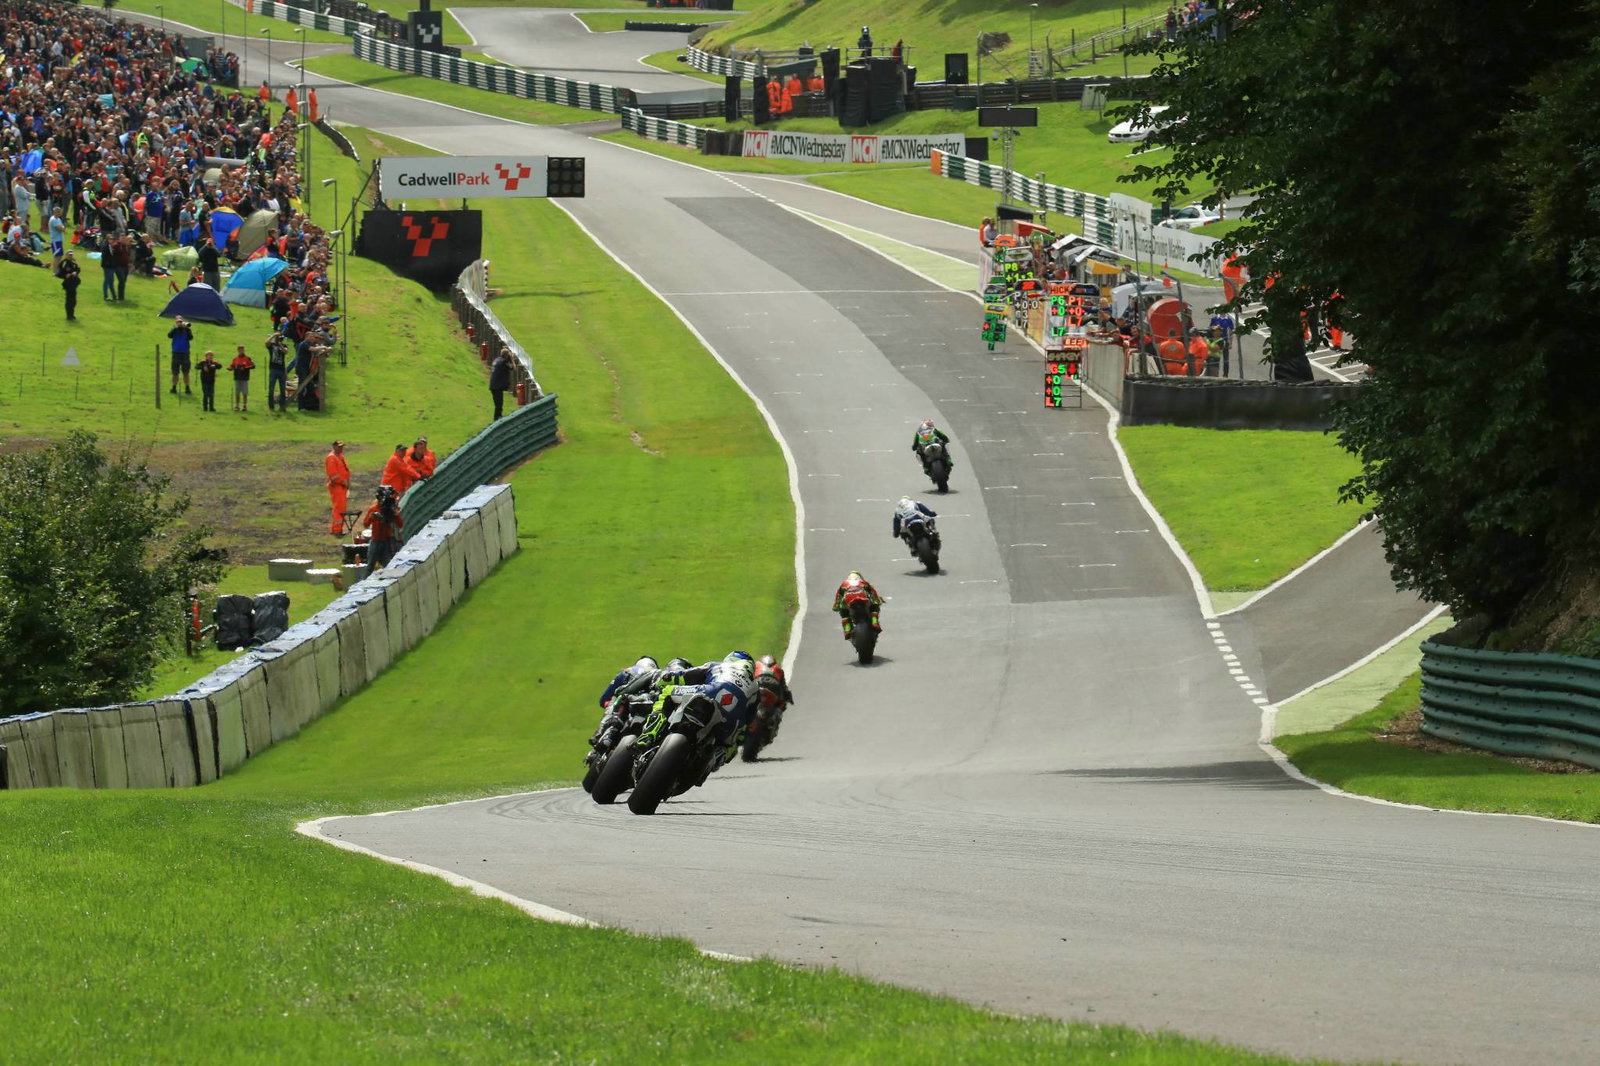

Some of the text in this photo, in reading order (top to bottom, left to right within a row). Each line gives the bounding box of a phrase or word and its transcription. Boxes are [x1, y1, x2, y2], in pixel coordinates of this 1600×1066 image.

[744, 132, 768, 157] MCN
[771, 135, 846, 162] #MCNWednesday
[852, 136, 877, 163] MCN
[398, 172, 490, 186] CadwellPark
[1005, 263, 1018, 272] P8
[1051, 296, 1065, 306] P6
[1069, 296, 1082, 306] P1
[1051, 326, 1065, 337] L7
[1045, 397, 1062, 407] L7
